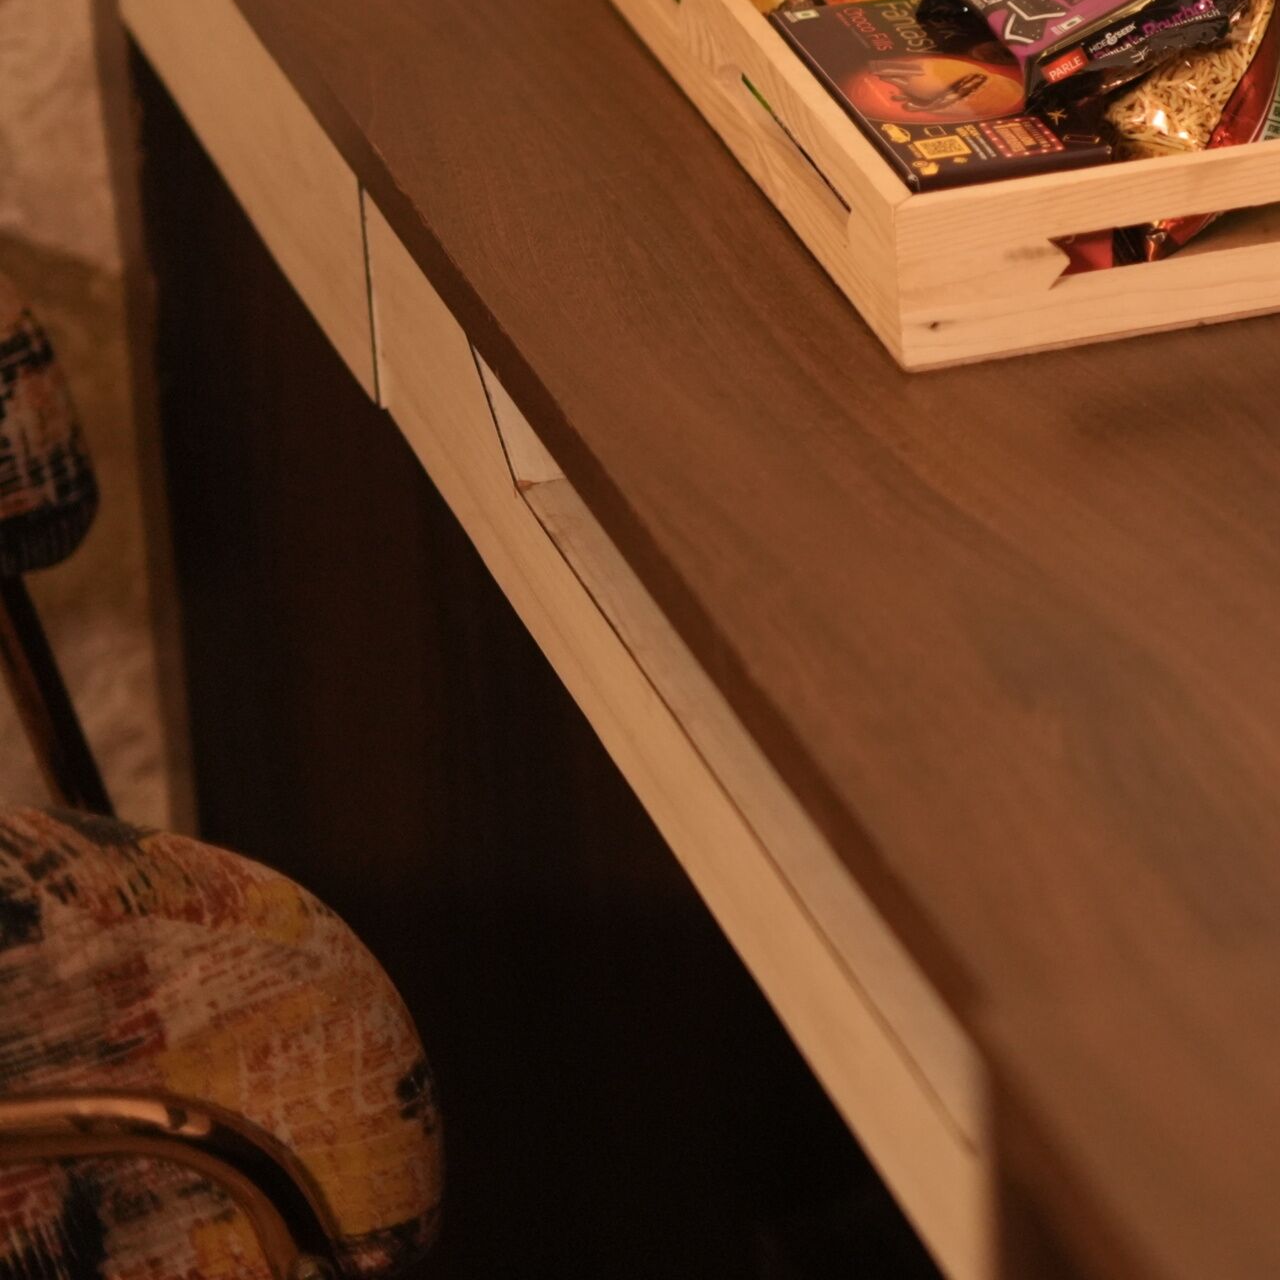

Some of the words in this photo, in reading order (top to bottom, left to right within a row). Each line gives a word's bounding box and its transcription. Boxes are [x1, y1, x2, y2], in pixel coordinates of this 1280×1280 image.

[843, 6, 876, 35] Choco
[867, 27, 893, 53] Fills
[876, 2, 943, 55] Fantasy
[1048, 56, 1084, 82] PARLE
